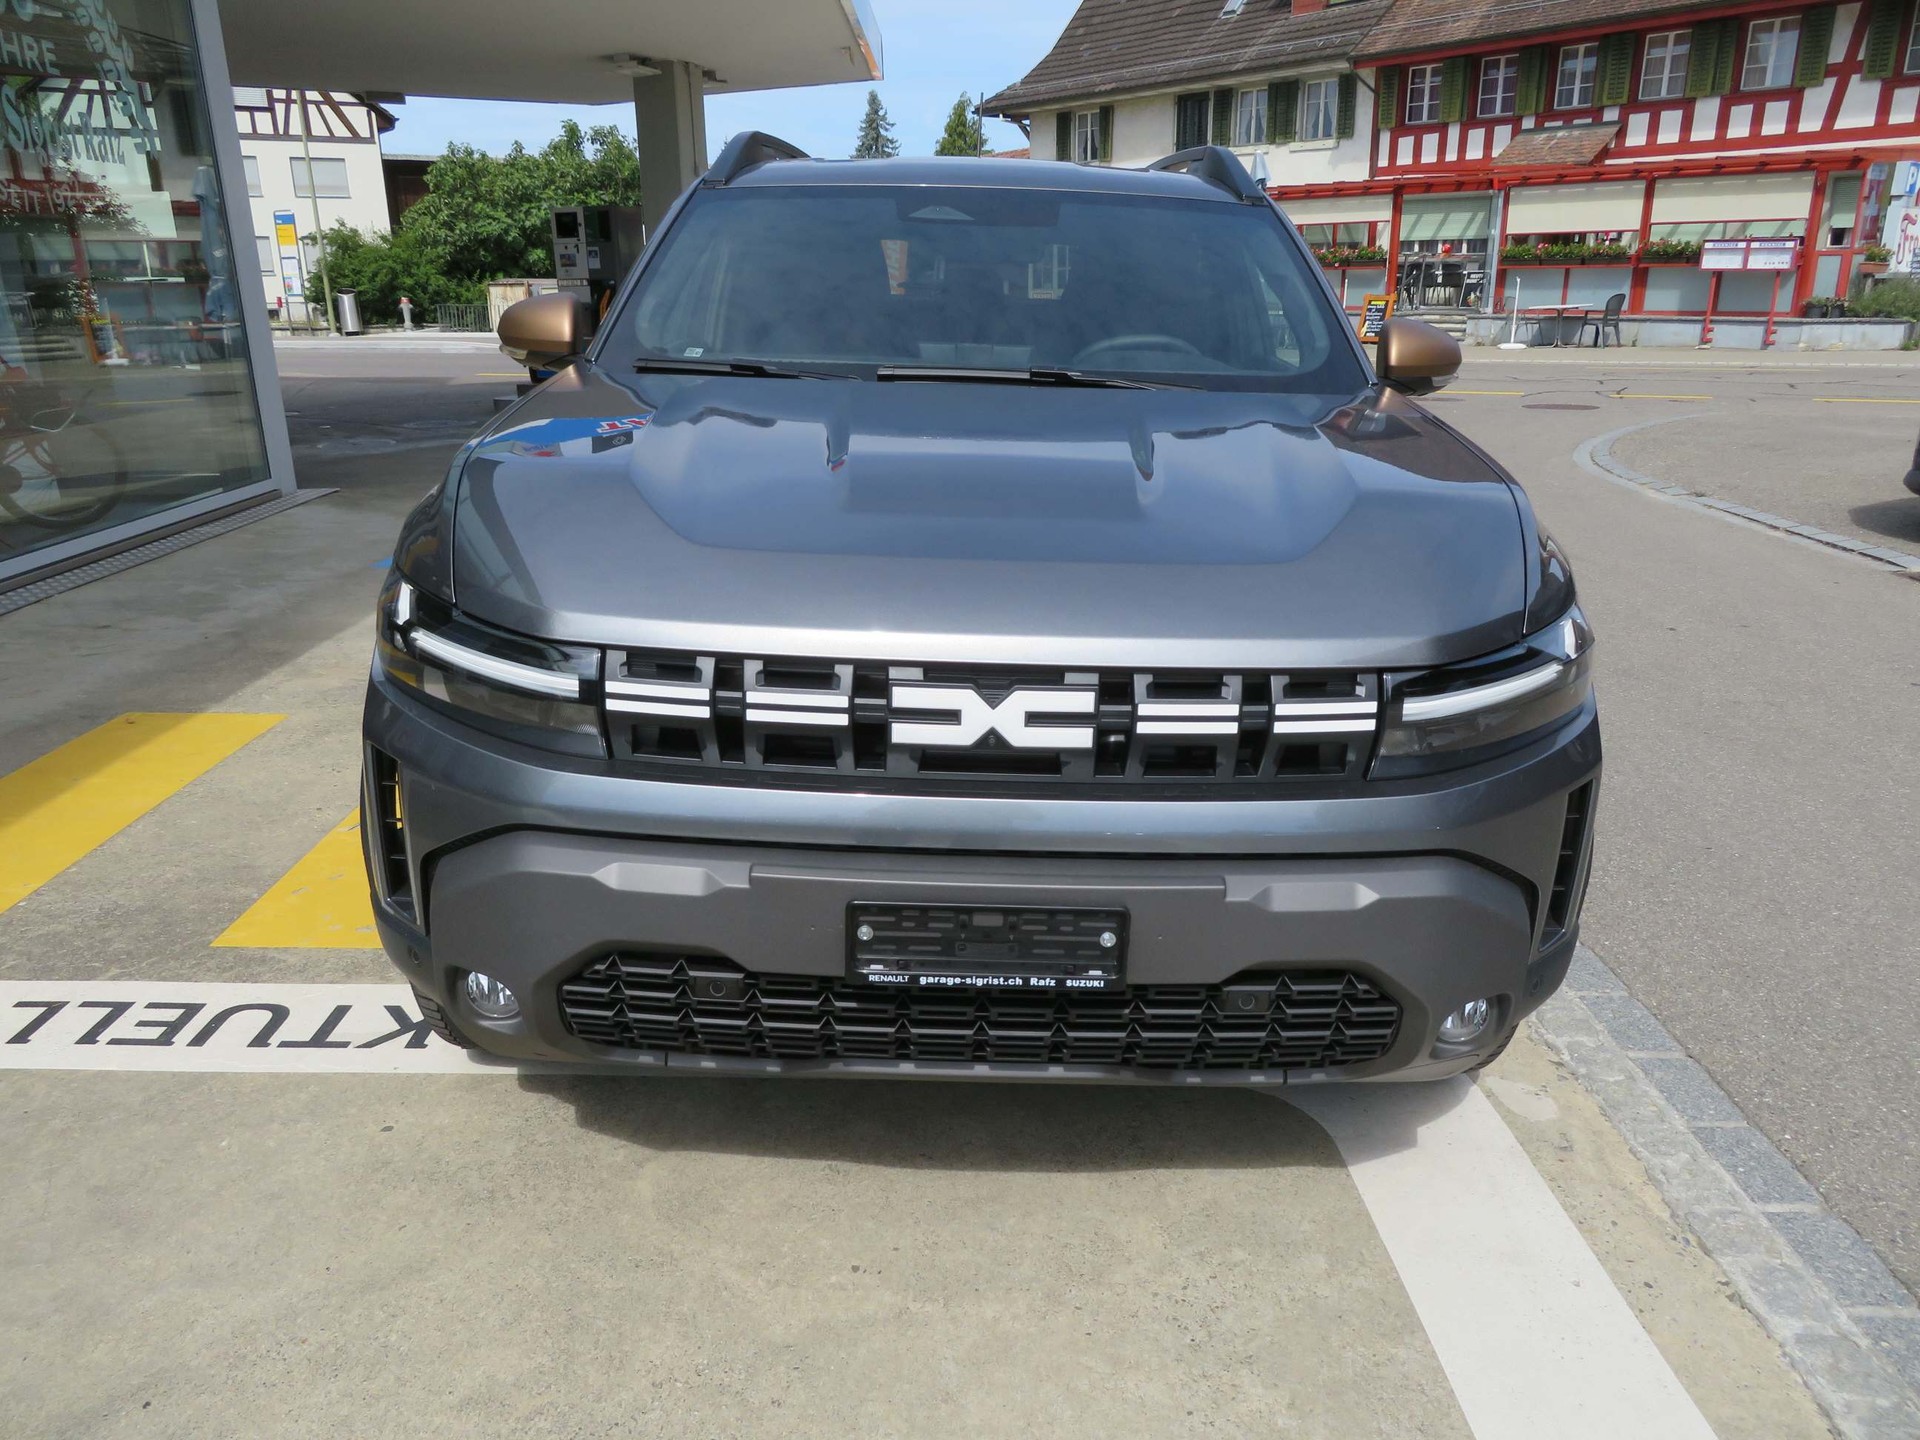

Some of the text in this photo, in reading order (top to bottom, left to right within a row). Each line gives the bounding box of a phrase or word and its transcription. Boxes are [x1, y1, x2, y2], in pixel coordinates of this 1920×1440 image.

[0, 27, 60, 76] HRE
[868, 974, 1105, 988] RENAULT garage-sigrist.ch Rafz SUZUKI
[5, 1000, 435, 1050] KTUELL
